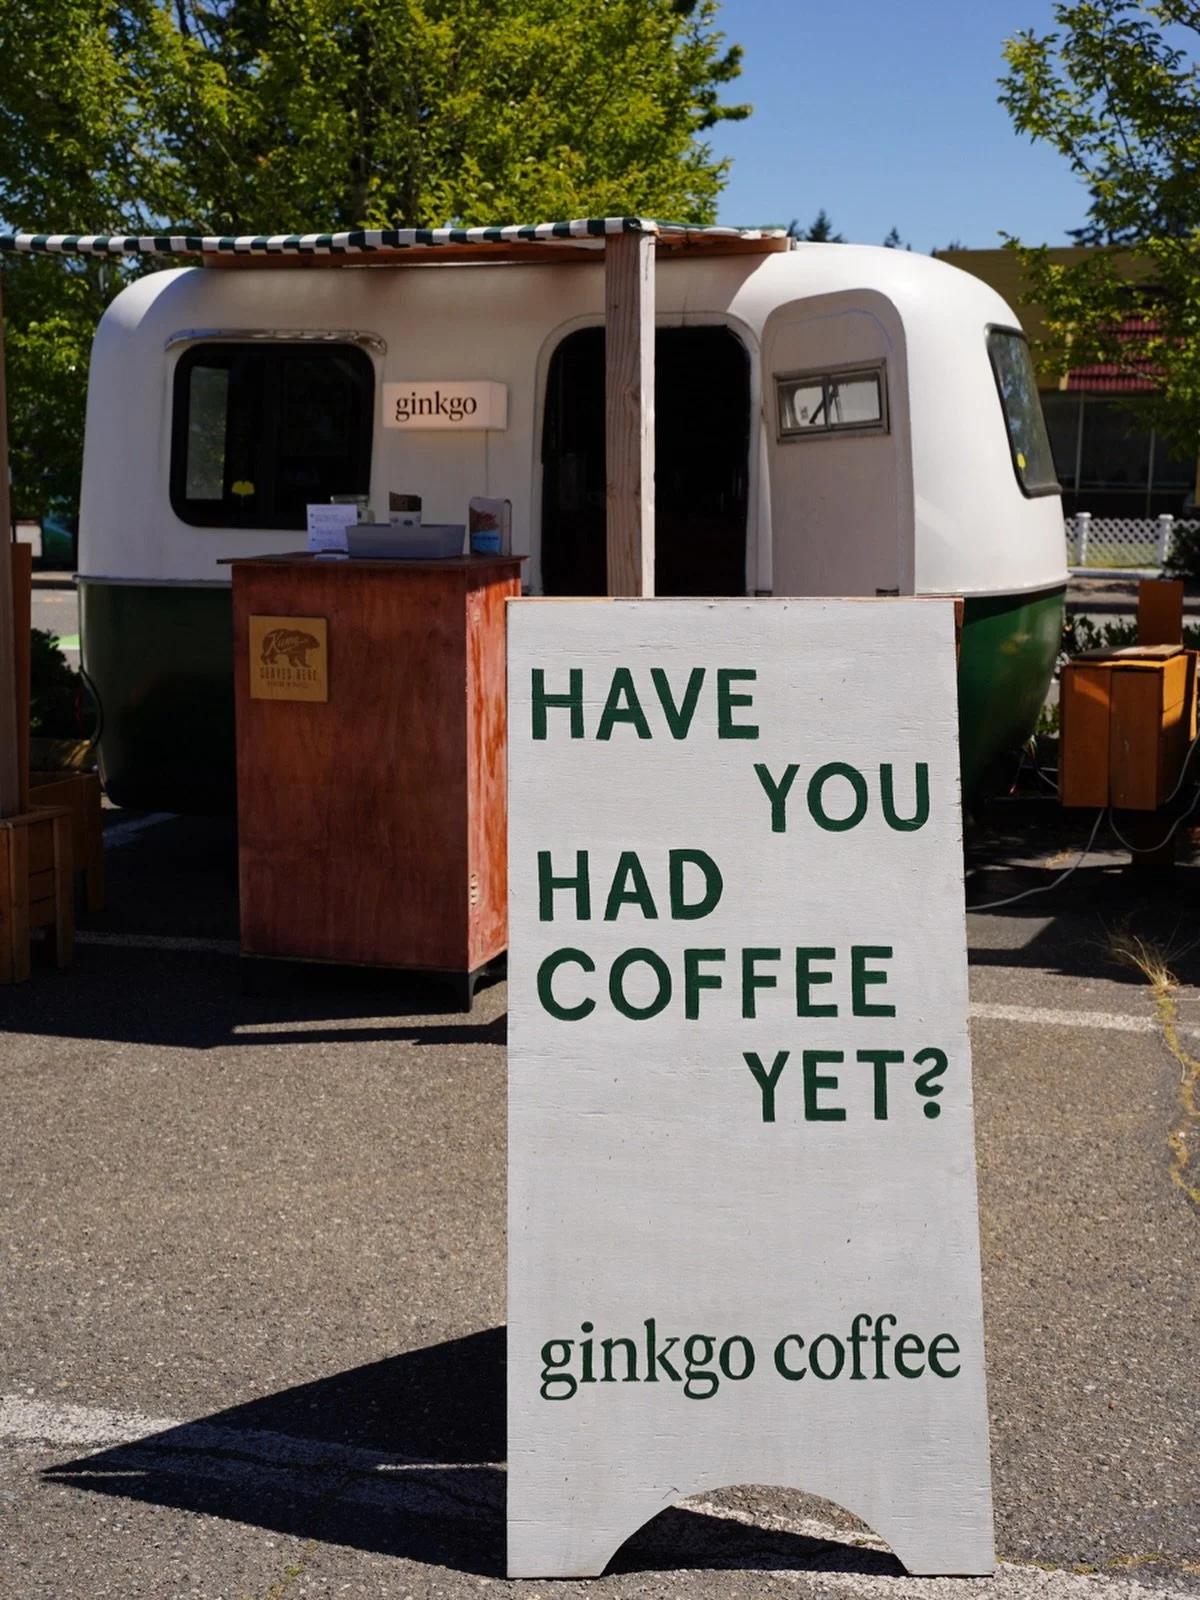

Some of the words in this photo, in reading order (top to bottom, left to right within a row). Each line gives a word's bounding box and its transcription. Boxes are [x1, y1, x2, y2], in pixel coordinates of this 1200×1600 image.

[395, 390, 477, 422] ginkgo
[531, 667, 760, 741] HAVE
[753, 761, 930, 833] YOU
[537, 848, 724, 922] HAD
[536, 945, 896, 1022] COFFEE
[742, 1047, 949, 1123] YET?
[539, 1317, 756, 1401] ginkgo
[773, 1313, 961, 1381] coffee
